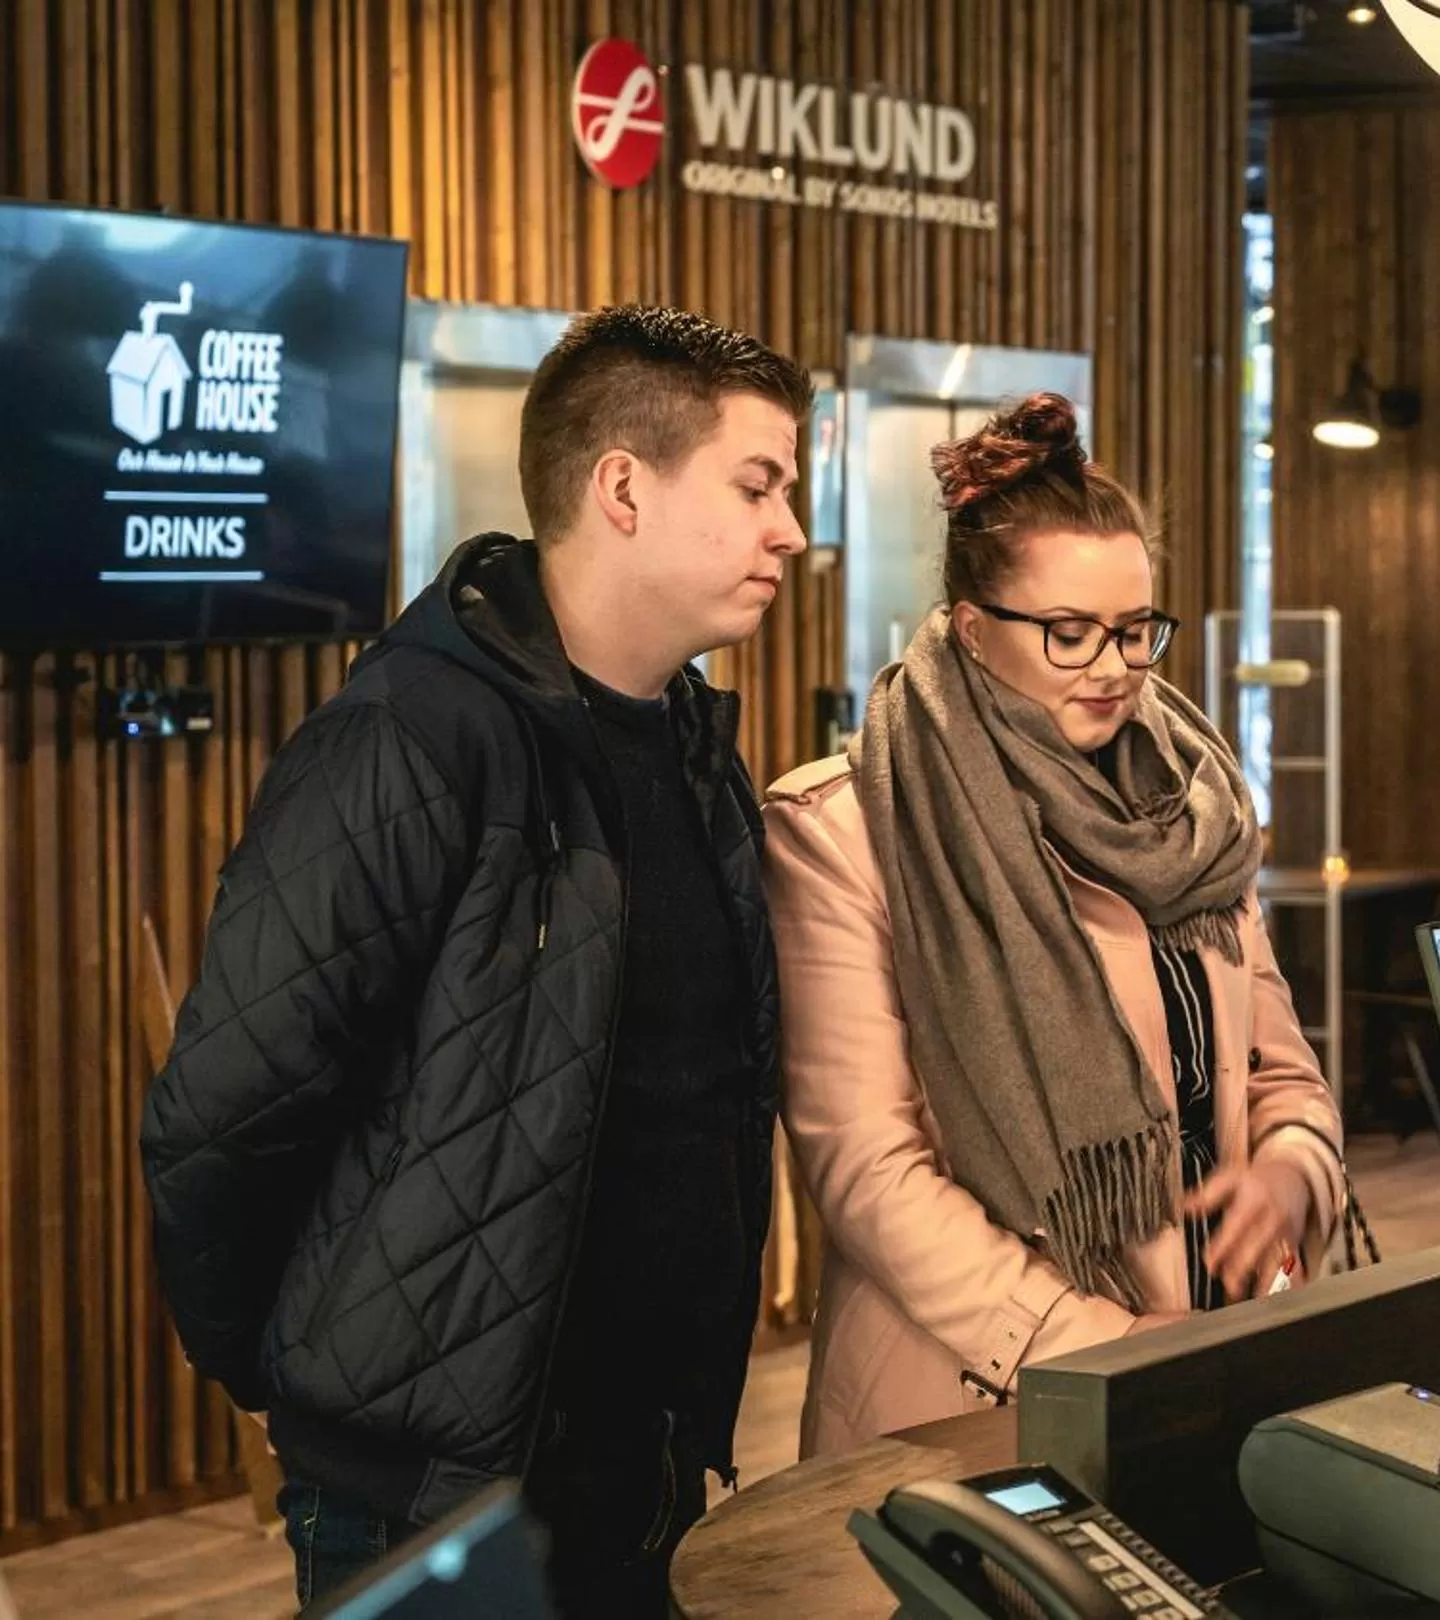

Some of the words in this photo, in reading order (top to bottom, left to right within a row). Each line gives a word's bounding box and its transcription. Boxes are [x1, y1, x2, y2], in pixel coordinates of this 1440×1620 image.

[684, 63, 976, 182] WIKLUND
[683, 160, 799, 204] ORIGINAL
[803, 176, 837, 208] BY
[915, 192, 998, 230] HOTELS
[199, 329, 283, 381] COFFEE
[195, 380, 280, 432] HOUSE
[124, 515, 246, 558] DRINKS
